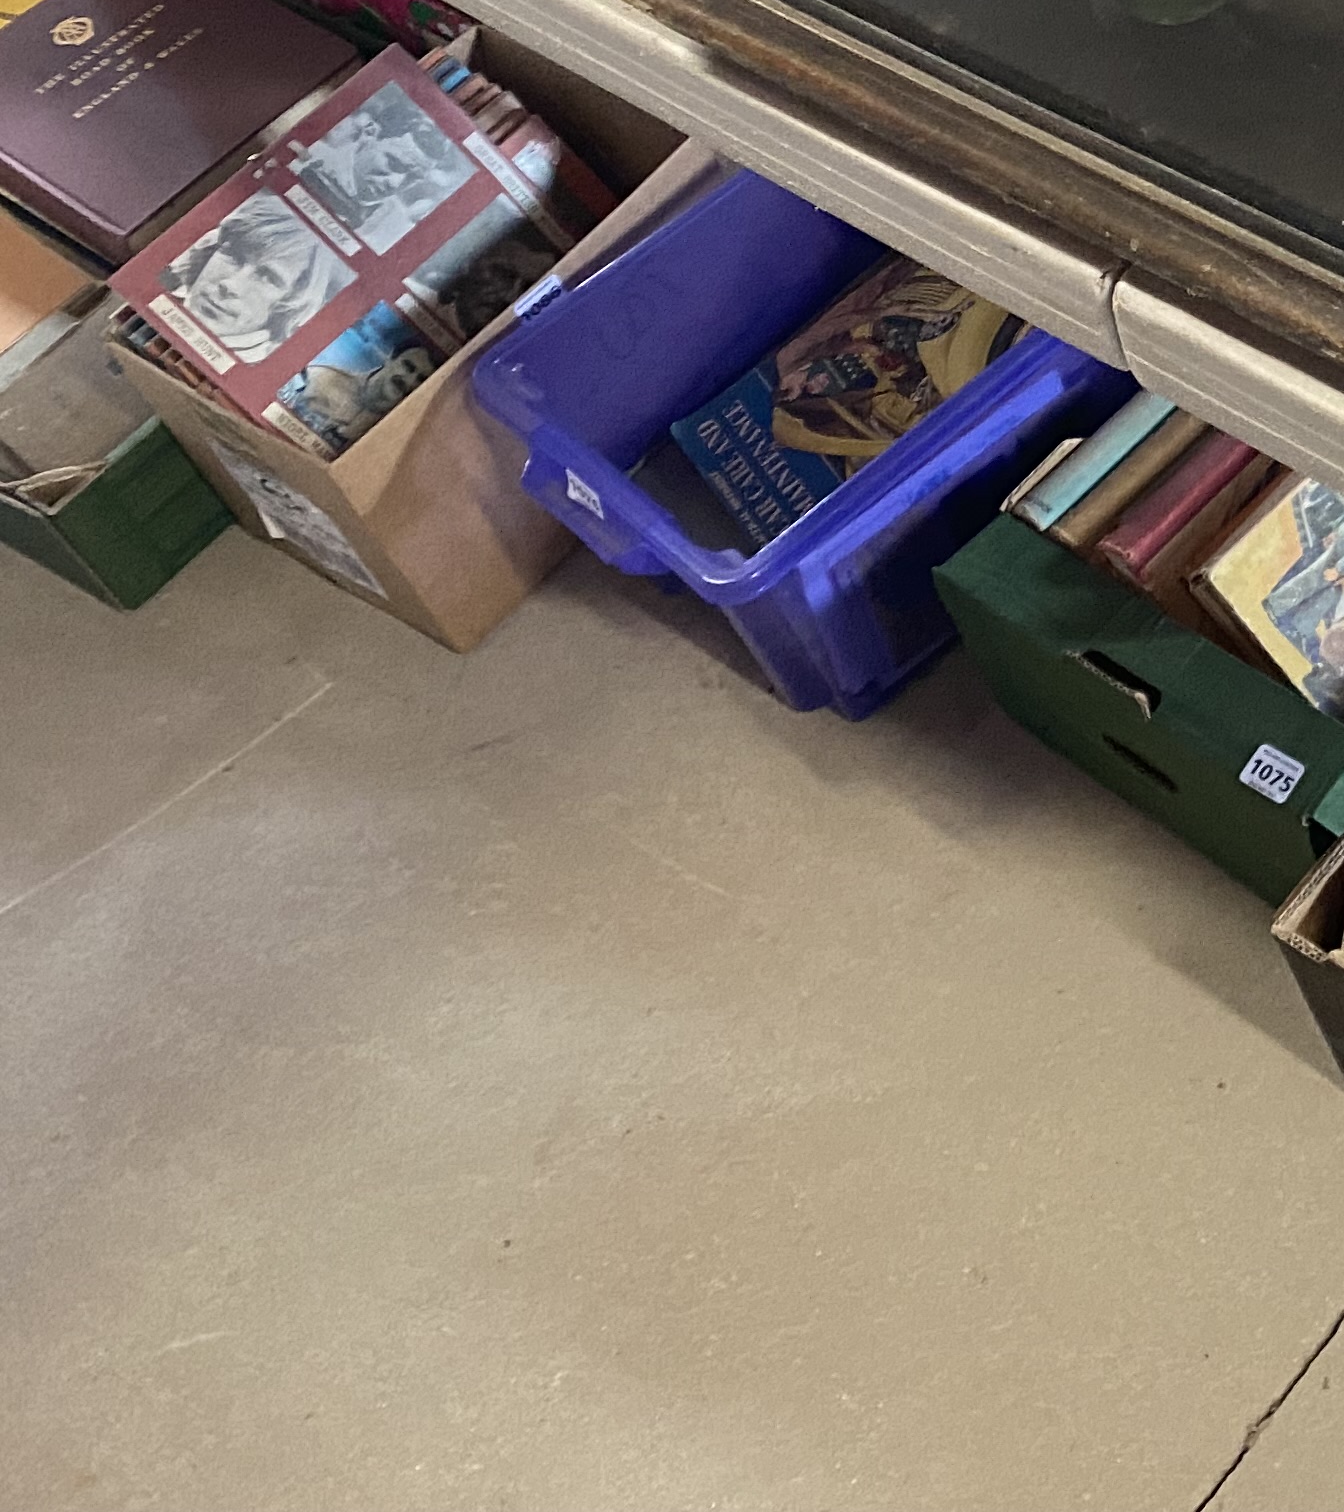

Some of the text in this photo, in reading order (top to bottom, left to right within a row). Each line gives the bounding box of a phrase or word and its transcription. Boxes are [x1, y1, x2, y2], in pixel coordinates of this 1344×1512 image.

[68, 4, 165, 71] ILLUSTRATED
[70, 29, 155, 86] ROAD BOOK
[72, 71, 140, 119] ENGLAND
[193, 335, 223, 361] HUNT
[697, 418, 727, 455] AND
[722, 399, 818, 513] MAINTENANCE
[722, 450, 759, 502] CARE
[1250, 758, 1295, 793] 1075
